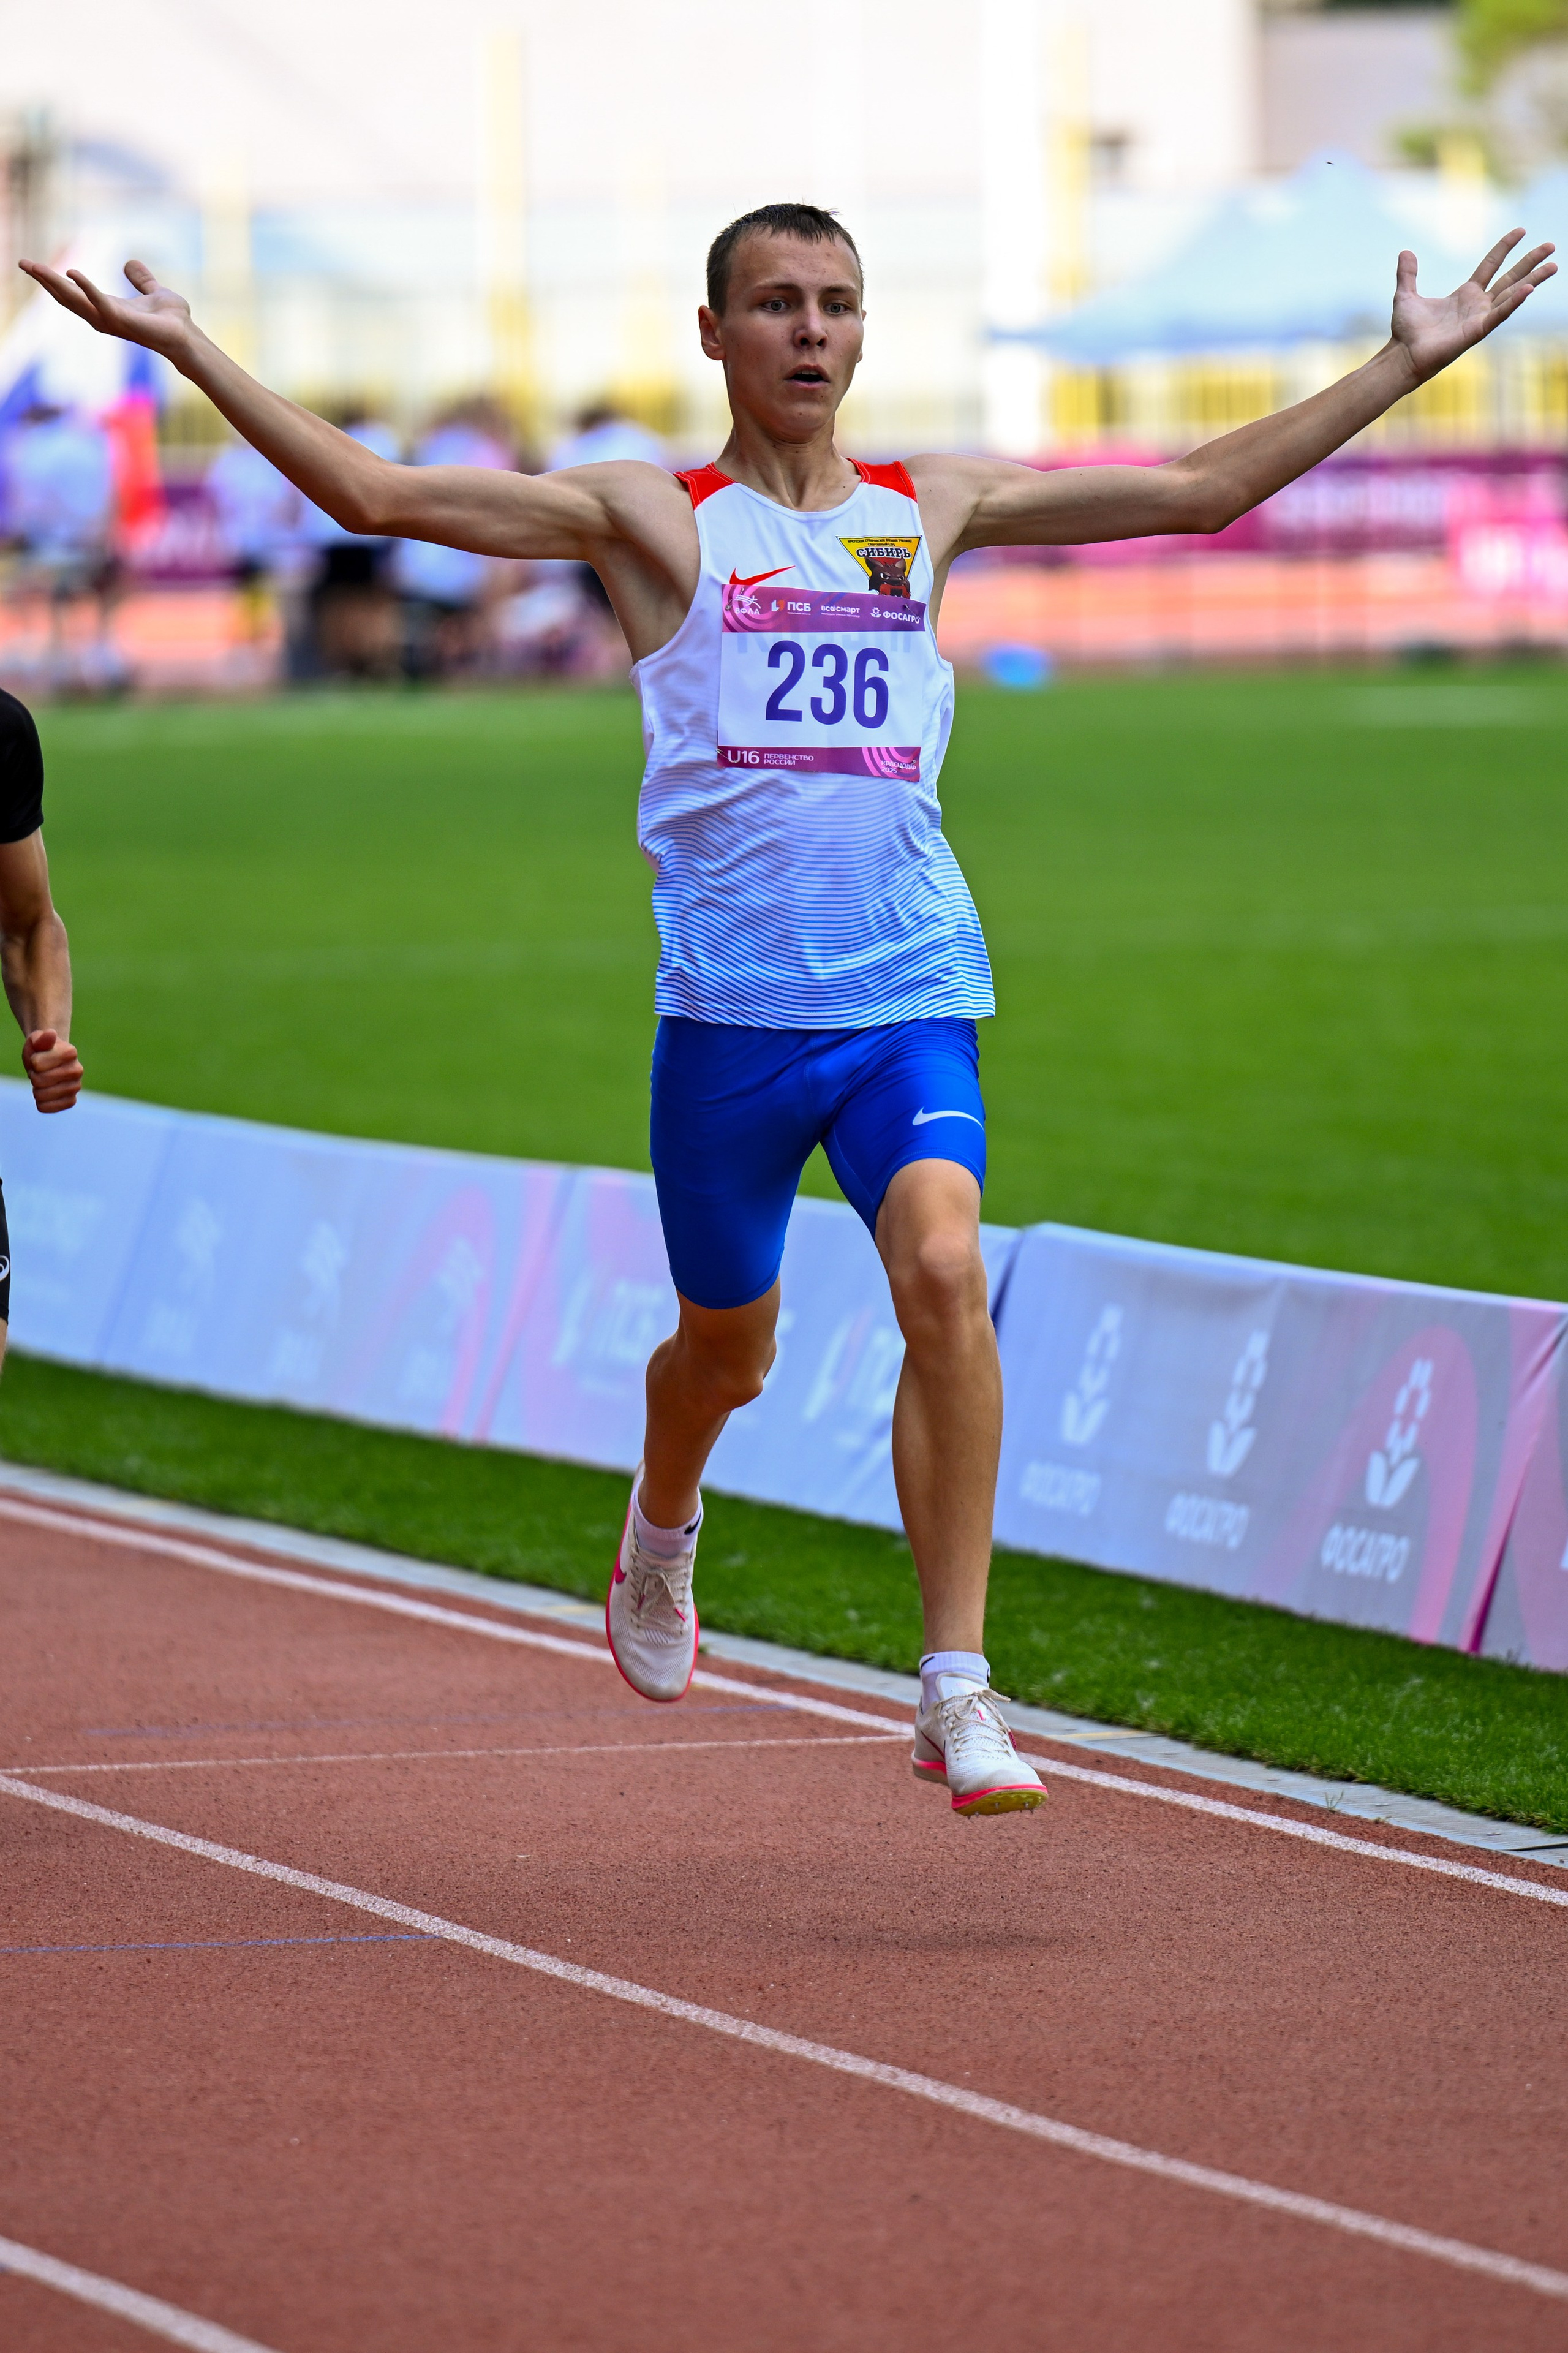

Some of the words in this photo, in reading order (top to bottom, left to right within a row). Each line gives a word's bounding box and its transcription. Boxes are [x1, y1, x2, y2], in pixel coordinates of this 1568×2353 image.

[856, 547, 911, 558] СИБИРЬ
[787, 602, 812, 612] ПСБ
[883, 611, 920, 624] ФОСАГРО
[766, 640, 889, 728] 236
[728, 750, 760, 764] U16
[881, 760, 916, 770] КРАСНОДАР
